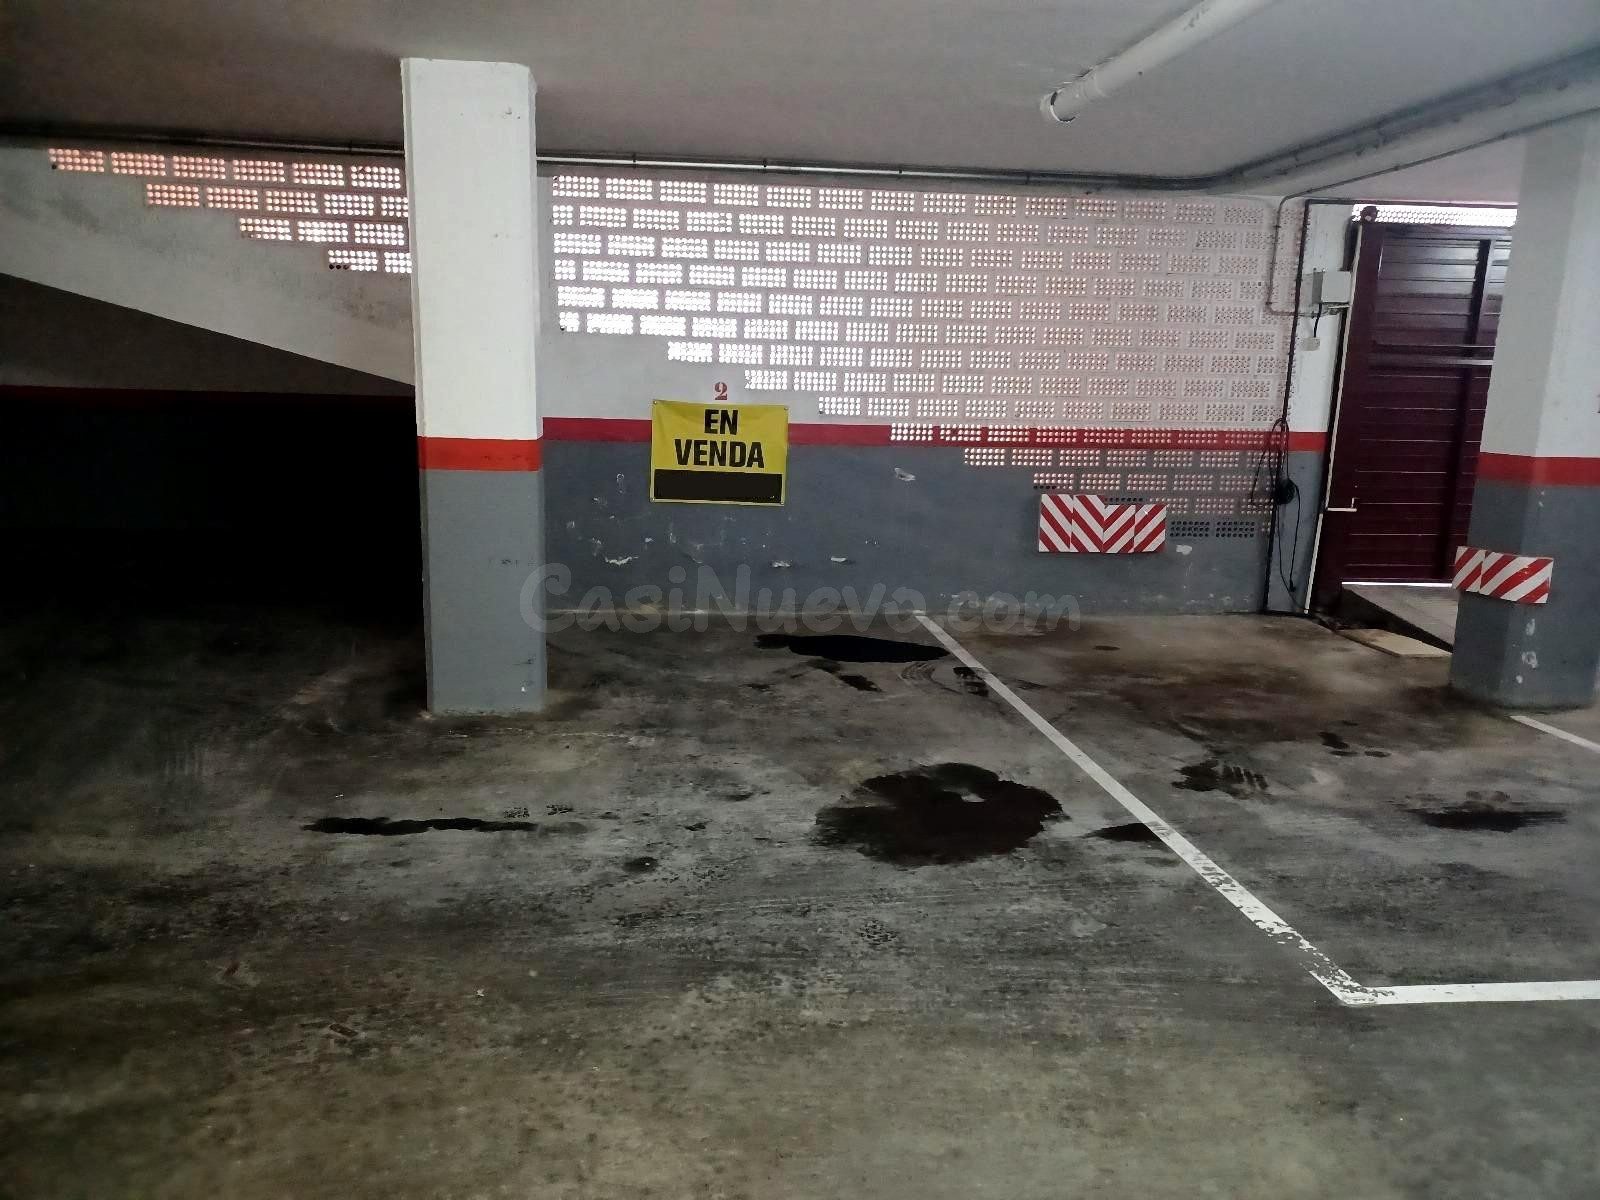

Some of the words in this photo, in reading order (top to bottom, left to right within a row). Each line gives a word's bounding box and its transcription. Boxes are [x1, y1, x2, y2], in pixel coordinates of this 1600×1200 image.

[714, 381, 728, 401] 2
[704, 409, 739, 435] EN
[674, 438, 765, 468] VENDA
